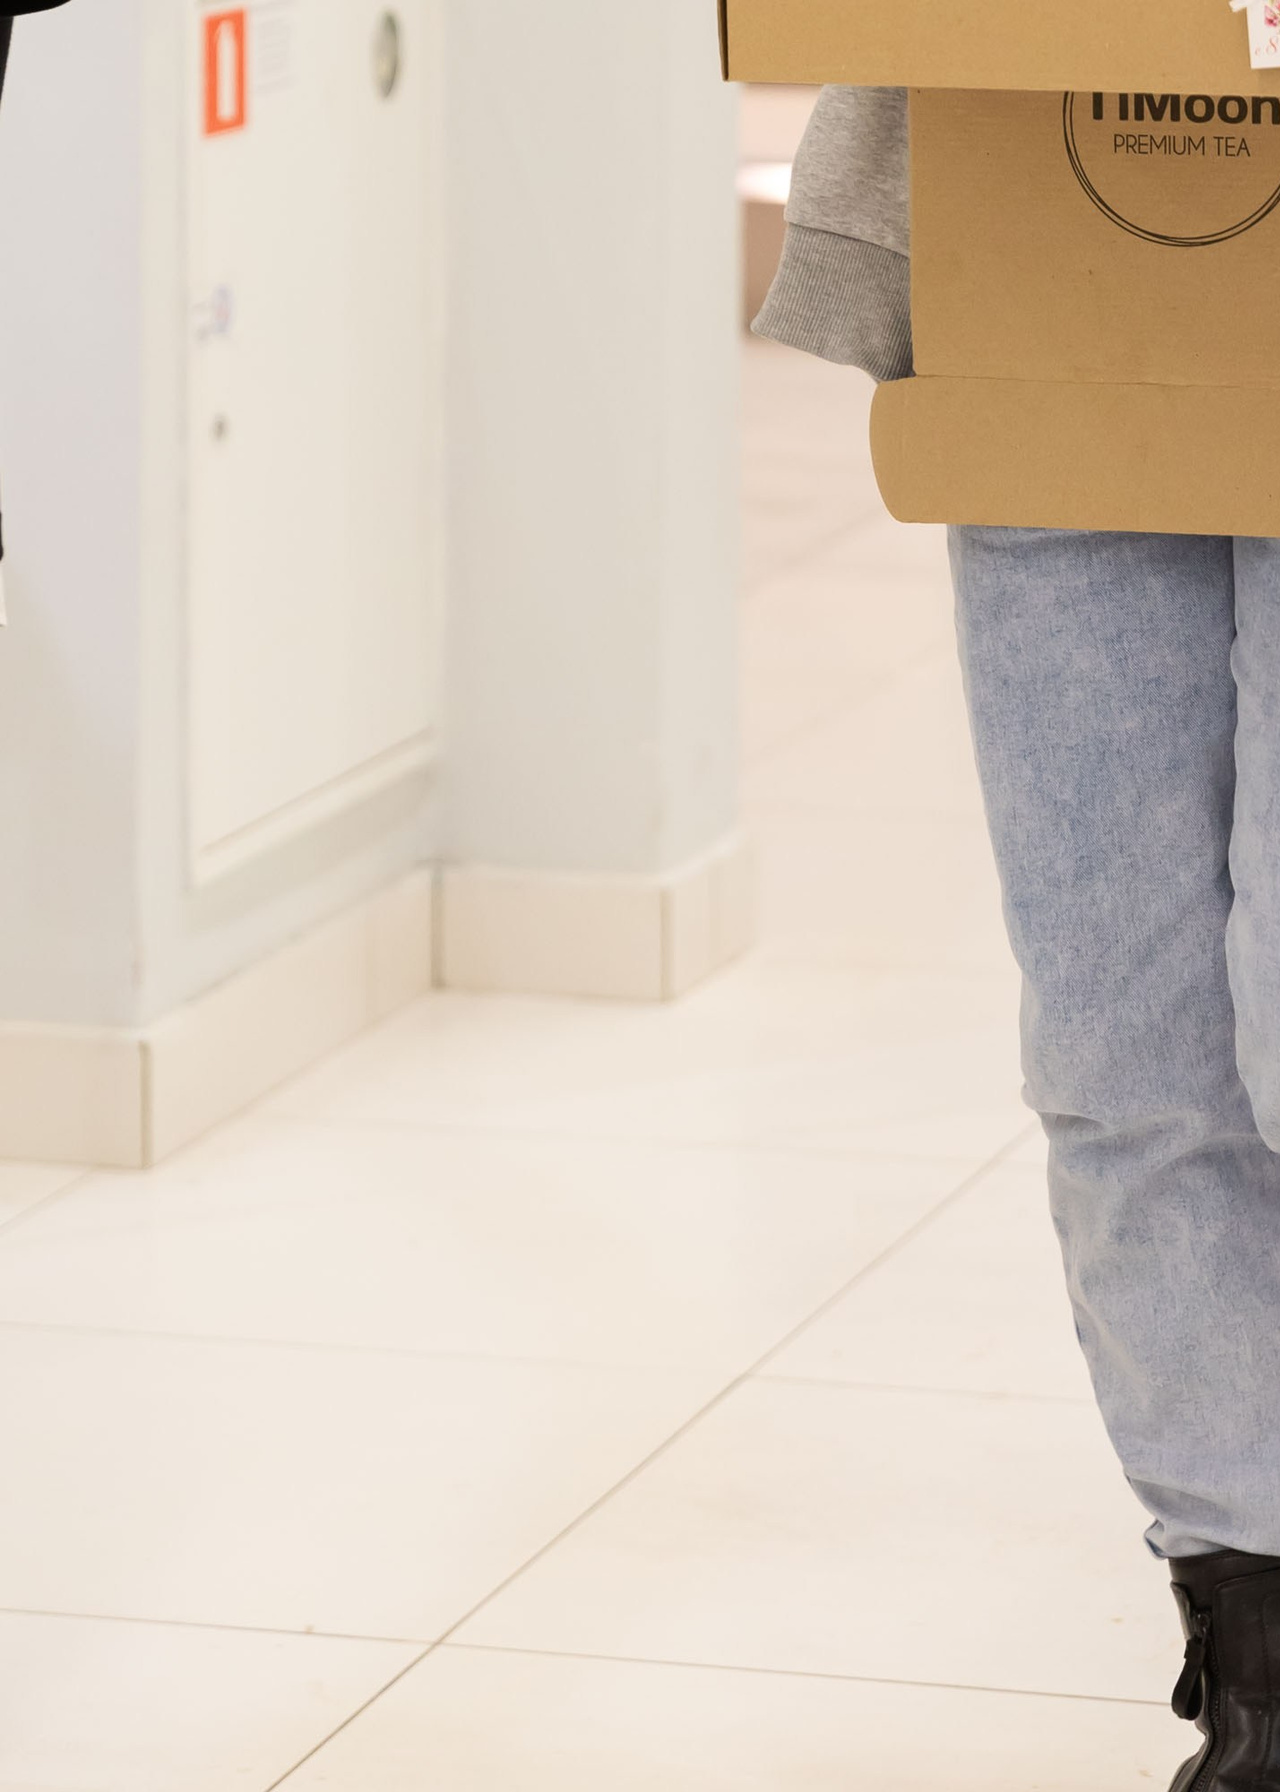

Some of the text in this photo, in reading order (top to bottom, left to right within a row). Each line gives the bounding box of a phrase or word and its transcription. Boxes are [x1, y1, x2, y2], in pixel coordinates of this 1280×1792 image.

[1265, 35, 1280, 56] 8
[1113, 133, 1251, 157] PREMIUM TEA
